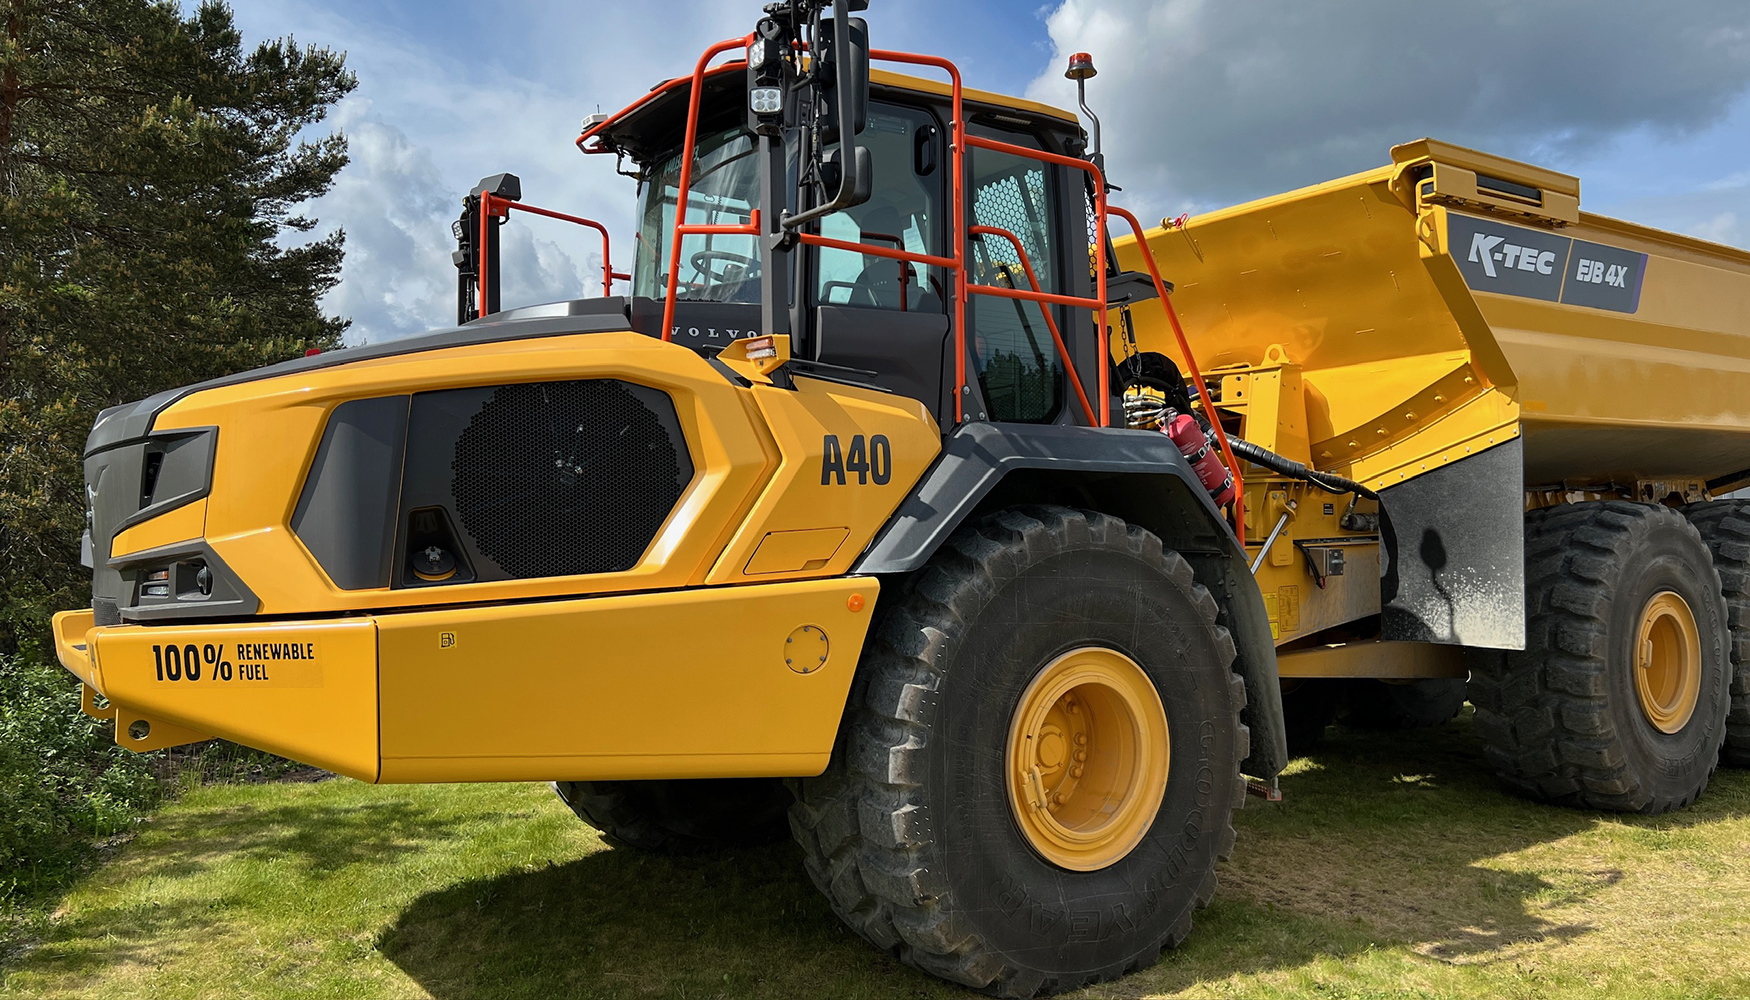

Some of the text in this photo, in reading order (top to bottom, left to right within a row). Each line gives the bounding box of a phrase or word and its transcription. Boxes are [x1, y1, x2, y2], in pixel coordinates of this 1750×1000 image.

[1467, 232, 1556, 278] K-TEC
[1575, 258, 1629, 288] EJB 4X
[671, 326, 757, 338] VOLVO
[821, 434, 892, 485] A40
[153, 643, 315, 682] 100% RENEWABLE
[239, 664, 269, 680] FUEL
